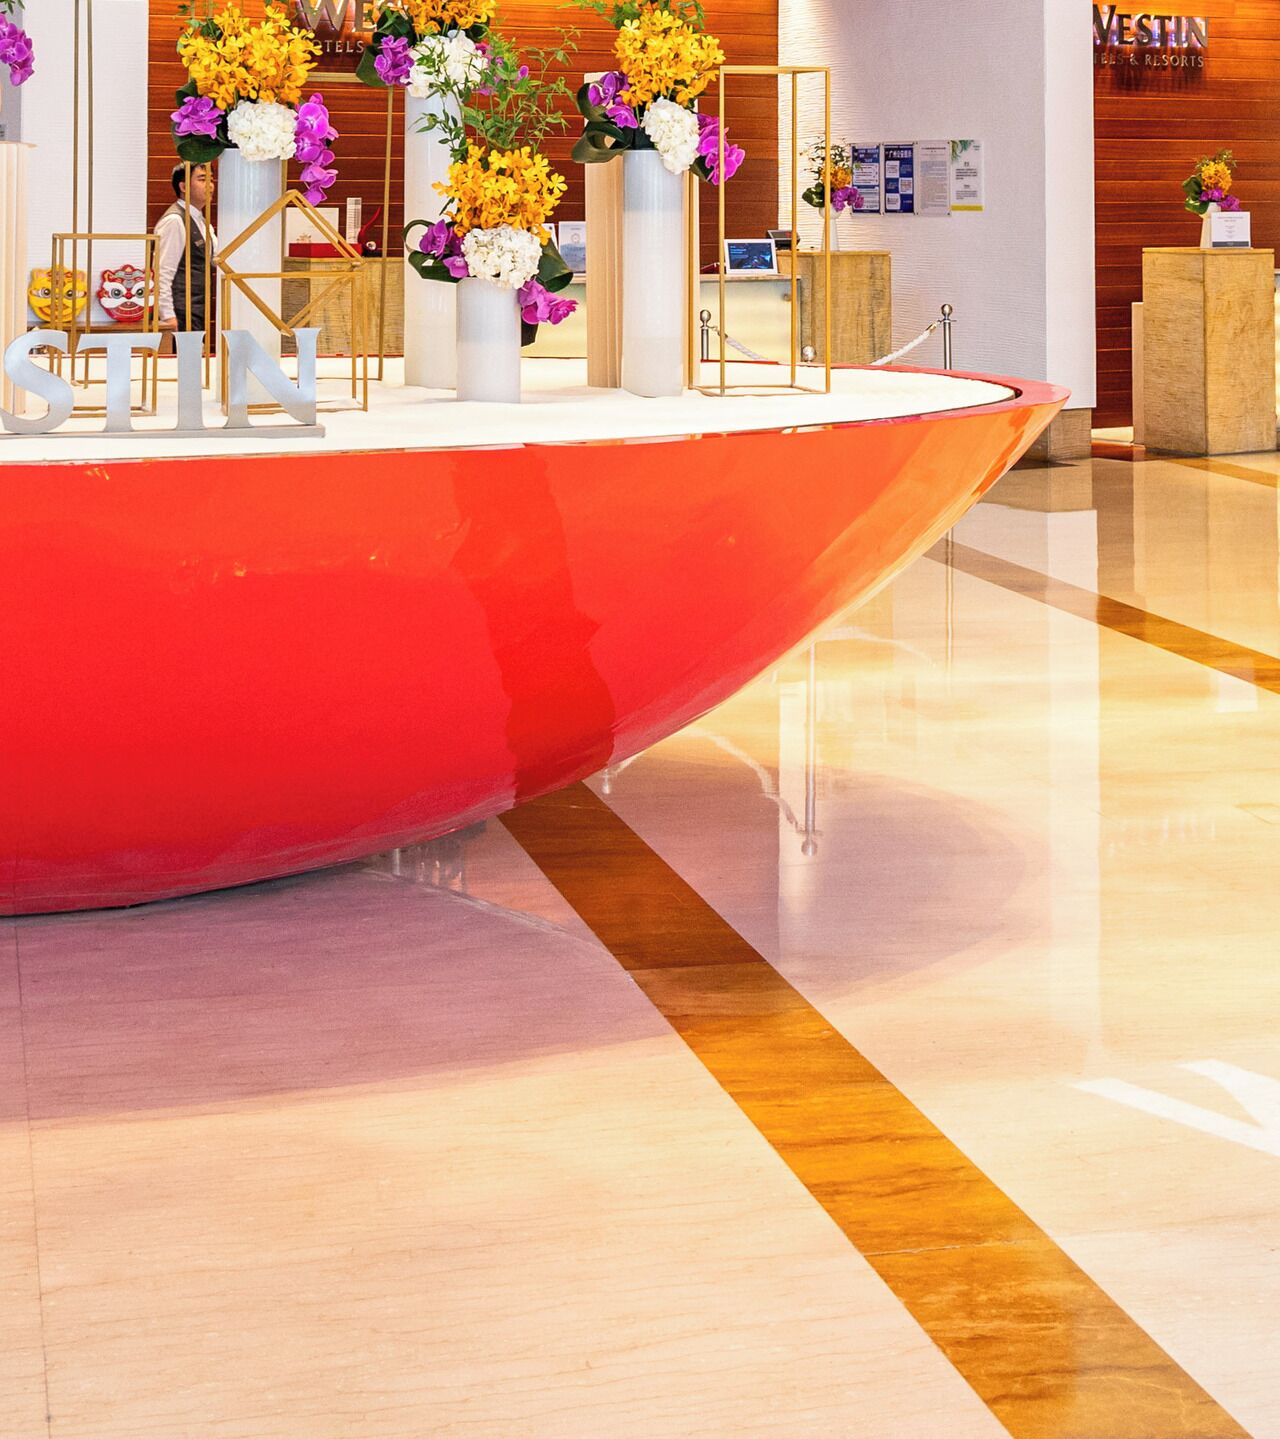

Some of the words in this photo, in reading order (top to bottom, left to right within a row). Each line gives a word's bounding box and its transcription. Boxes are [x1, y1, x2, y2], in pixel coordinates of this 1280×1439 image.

[312, 40, 365, 53] TELS
[1094, 52, 1124, 65] TELS
[1129, 53, 1139, 66] &
[1145, 54, 1204, 67] RESORTS
